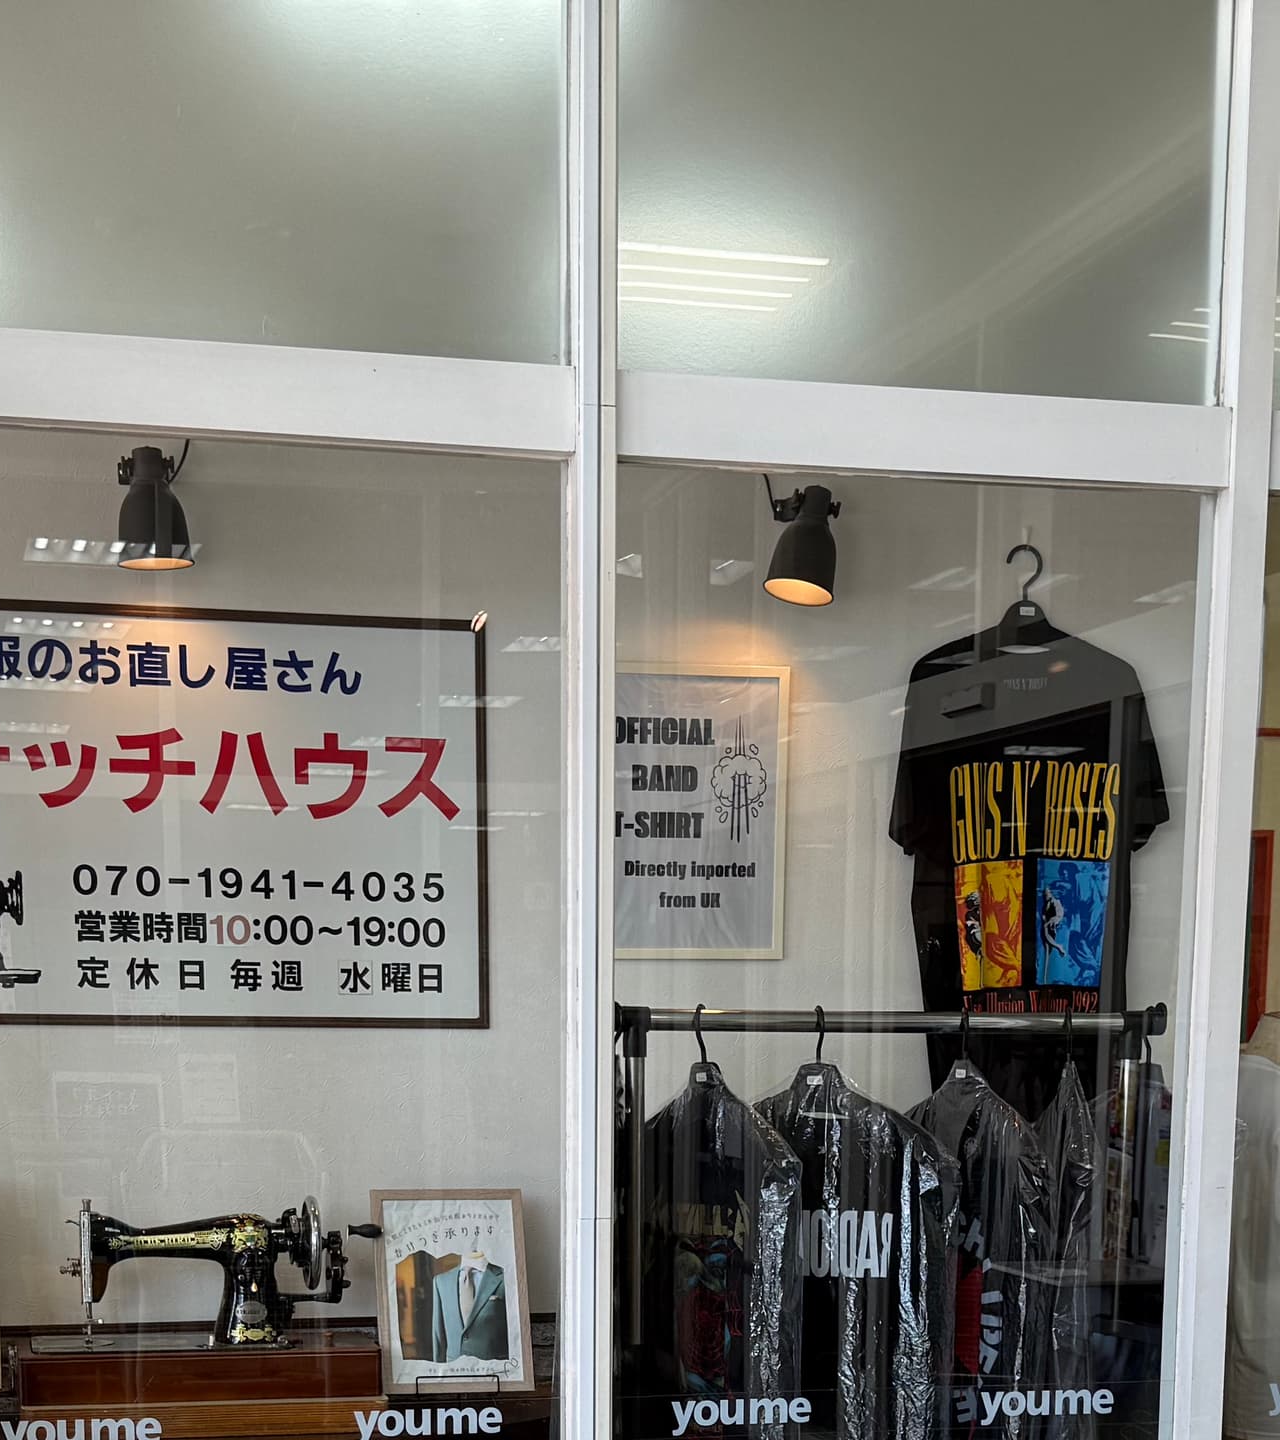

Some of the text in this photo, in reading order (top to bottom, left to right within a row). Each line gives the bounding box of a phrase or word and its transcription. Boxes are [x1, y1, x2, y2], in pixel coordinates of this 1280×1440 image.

[631, 764, 699, 793] BAND
[949, 761, 1004, 864] GUNS
[1041, 761, 1120, 861] ROSES
[72, 864, 446, 904] 070-1941-4035
[624, 860, 756, 881] Directly inported
[659, 892, 721, 909] from UK
[671, 1394, 813, 1437] youme
[980, 1385, 1116, 1426] youme
